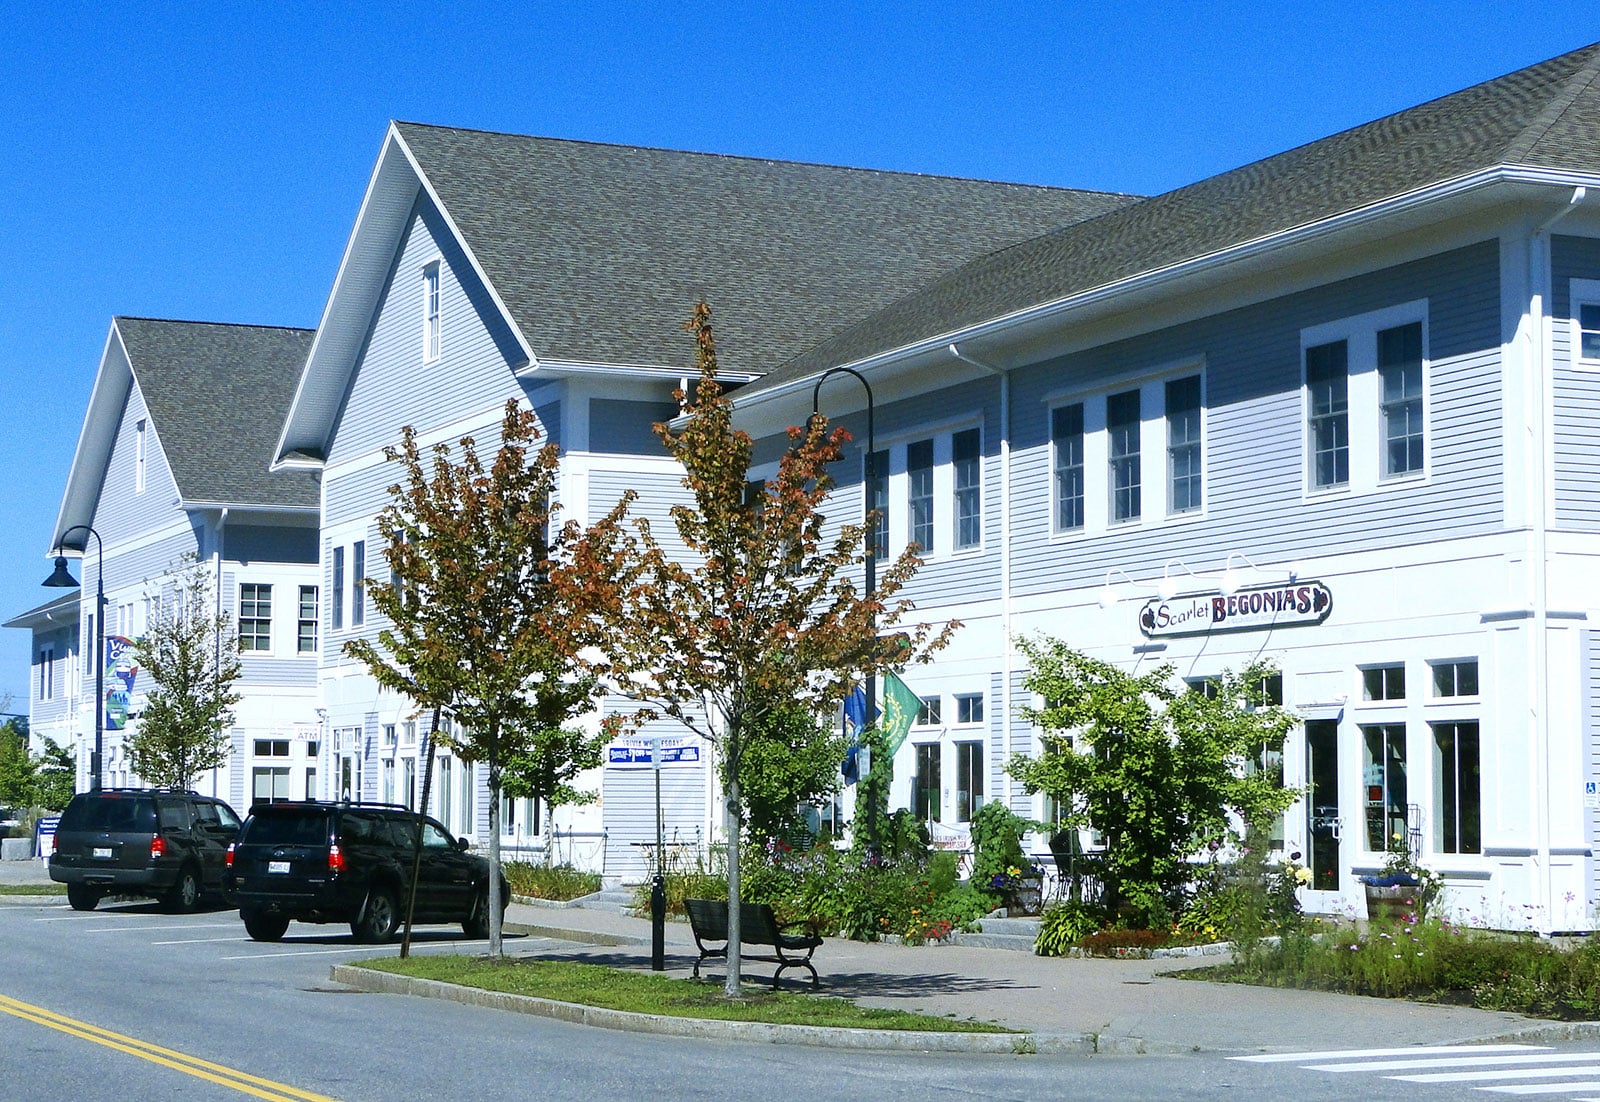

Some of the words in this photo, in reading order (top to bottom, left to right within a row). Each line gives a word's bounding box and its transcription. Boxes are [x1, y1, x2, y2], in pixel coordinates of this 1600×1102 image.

[1156, 601, 1209, 628] Scarlet
[1211, 587, 1312, 623] BEGONIAS
[297, 732, 318, 740] ATM
[622, 739, 642, 747] TRIVIA
